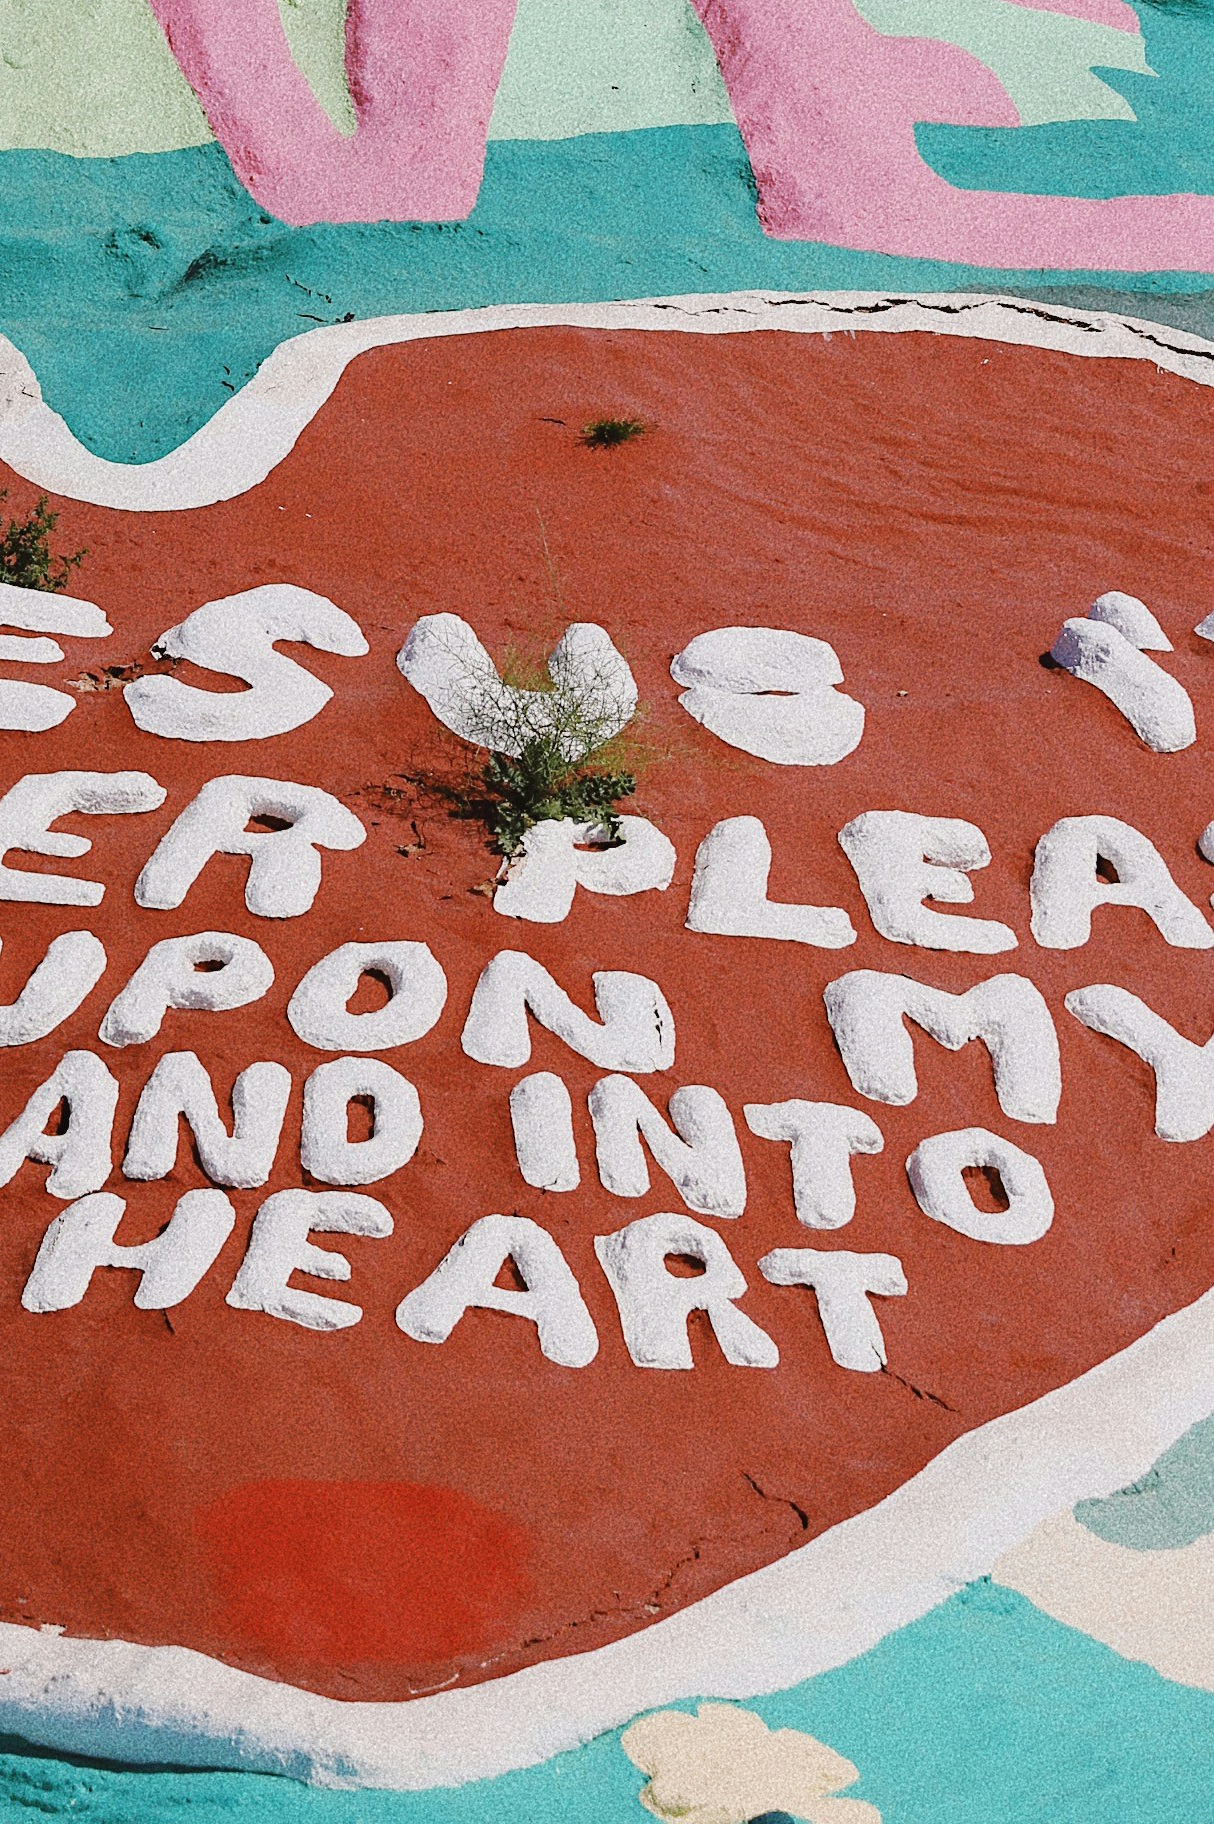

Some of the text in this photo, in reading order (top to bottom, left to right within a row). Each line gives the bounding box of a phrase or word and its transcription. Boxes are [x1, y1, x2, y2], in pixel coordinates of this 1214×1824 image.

[492, 809, 1214, 955] PLEA
[824, 968, 1214, 1144] MY
[509, 1071, 1056, 1247] INTO
[20, 1187, 910, 1374] HEART
